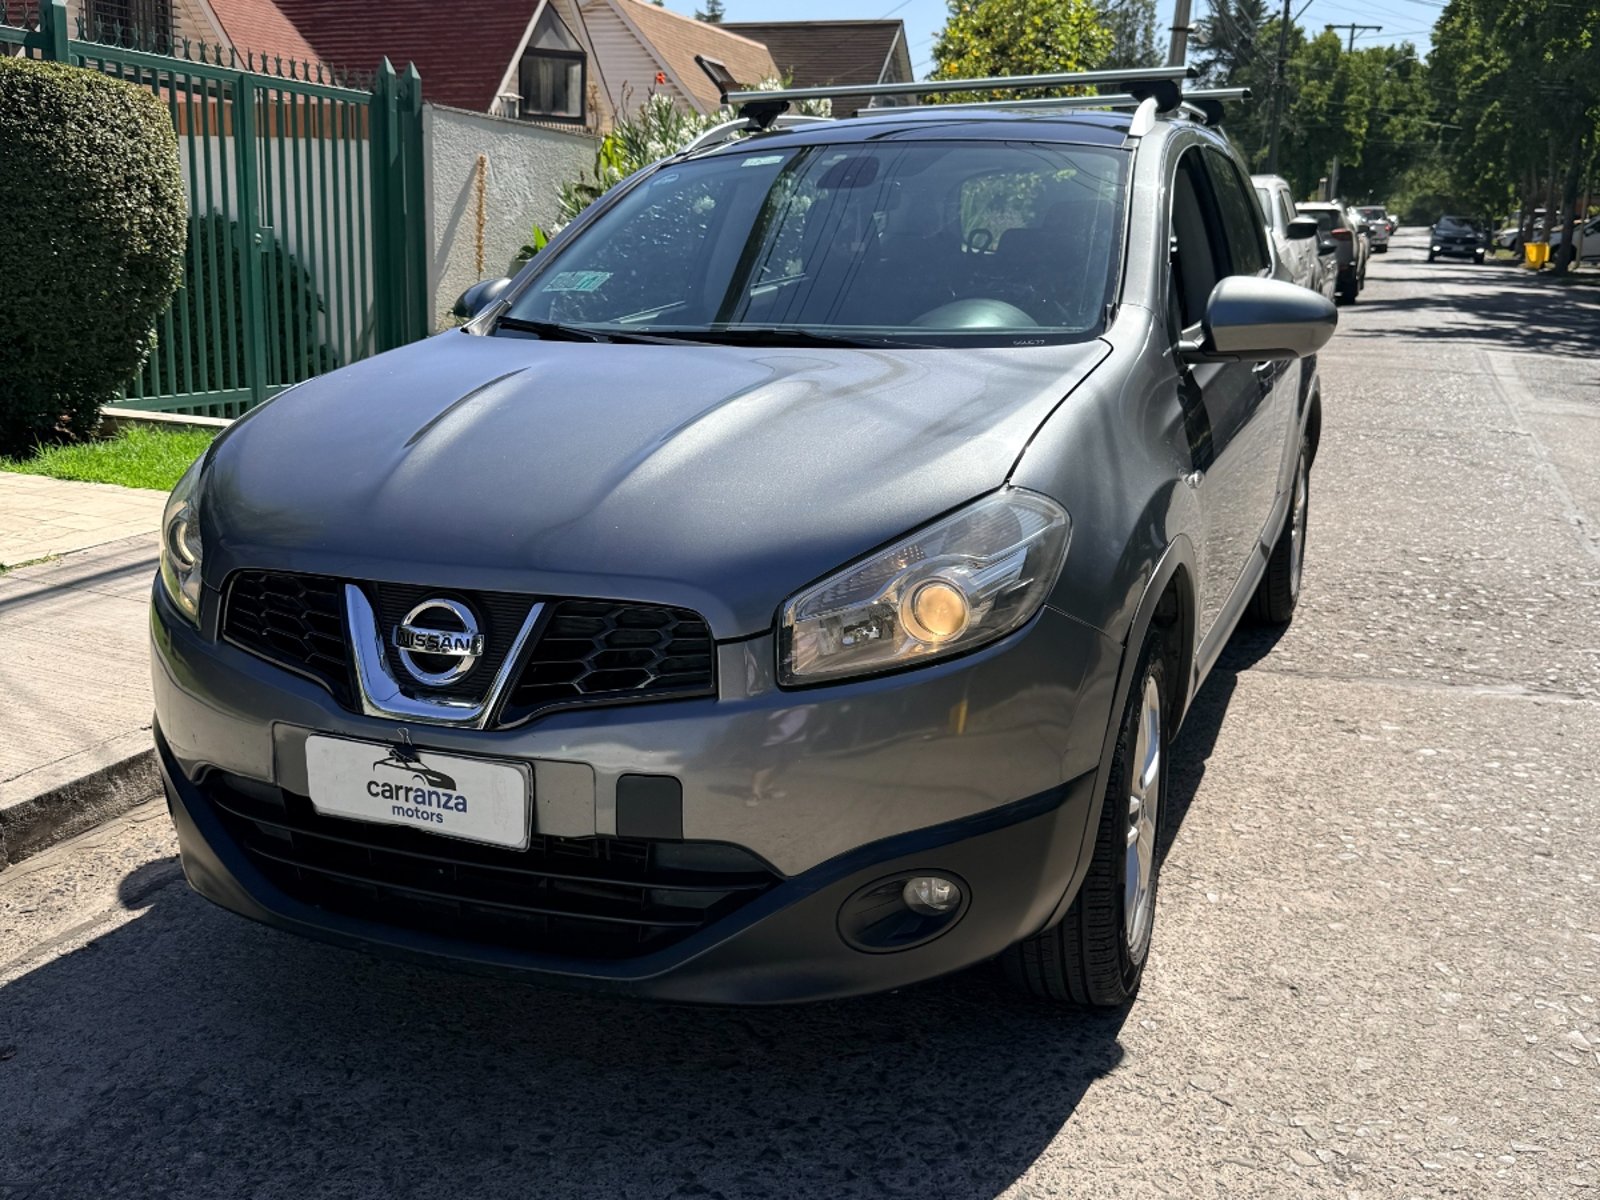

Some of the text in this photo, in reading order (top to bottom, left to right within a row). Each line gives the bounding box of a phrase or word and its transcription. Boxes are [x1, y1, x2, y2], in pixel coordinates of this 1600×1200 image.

[396, 631, 470, 651] NISSAN
[366, 780, 468, 813] carranza
[392, 804, 444, 823] motors
